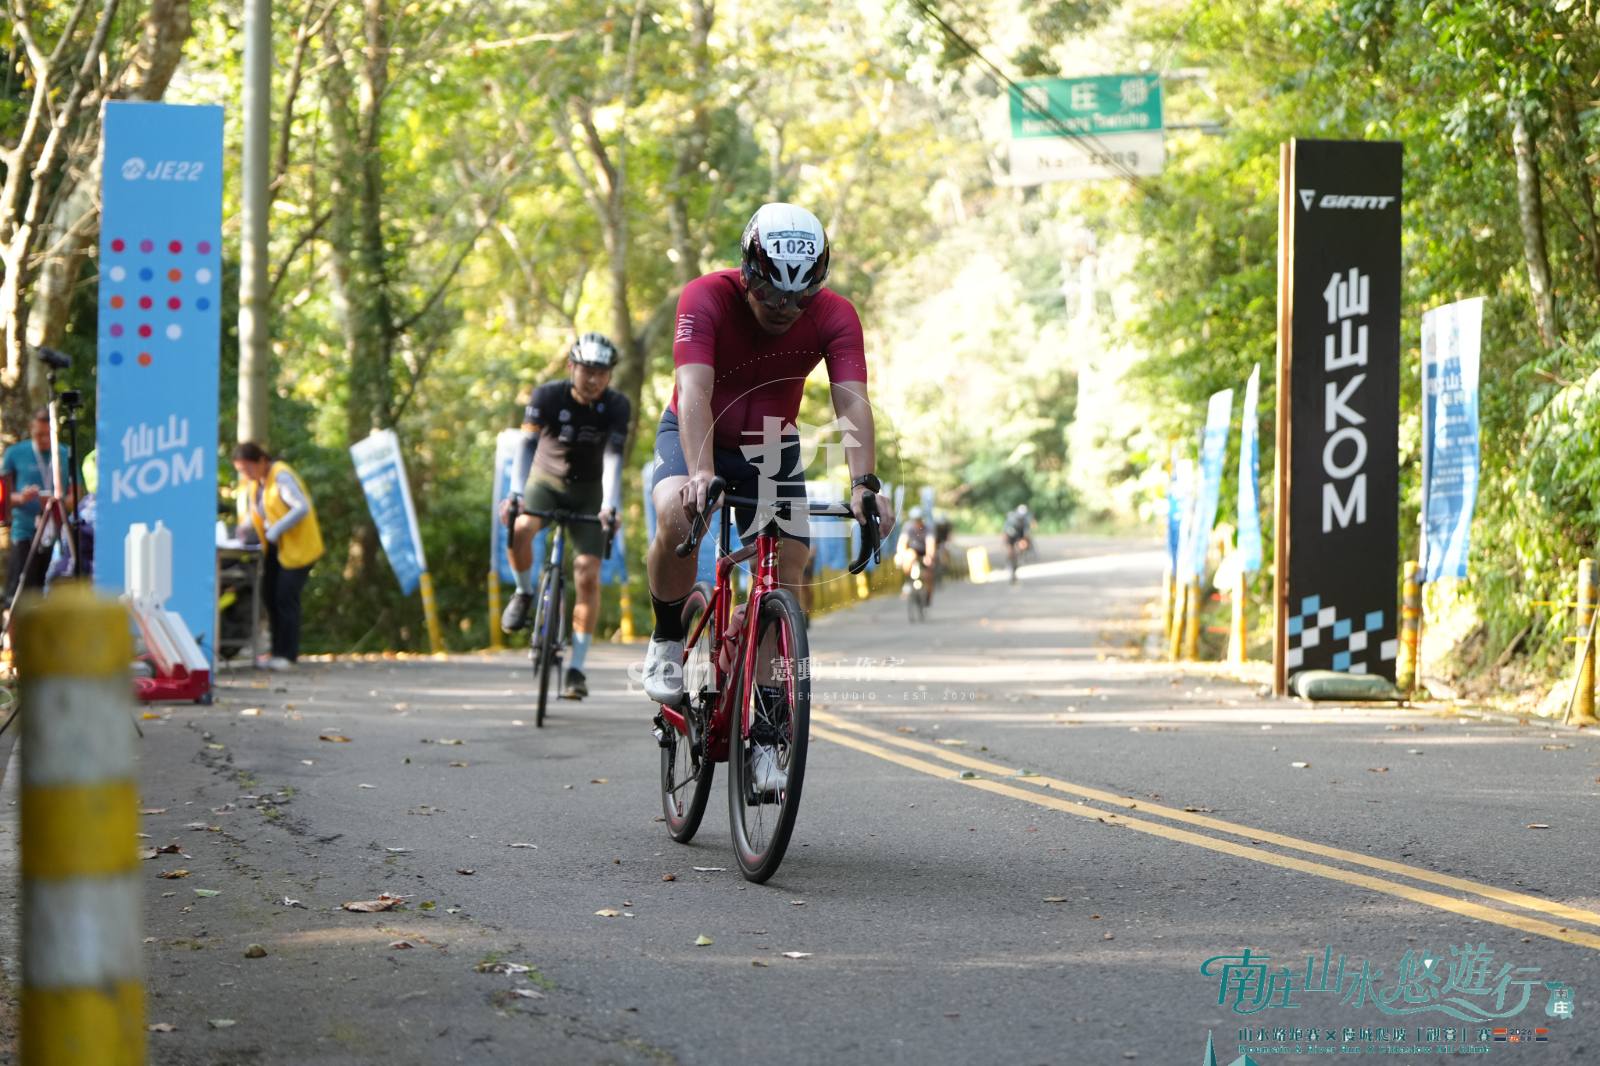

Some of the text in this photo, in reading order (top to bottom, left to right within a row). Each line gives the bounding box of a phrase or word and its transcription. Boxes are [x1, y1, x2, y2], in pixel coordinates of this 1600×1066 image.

[145, 160, 204, 180] JE22
[1319, 195, 1396, 210] GIANT
[121, 413, 188, 463] 仙山
[111, 446, 204, 503] KOM
